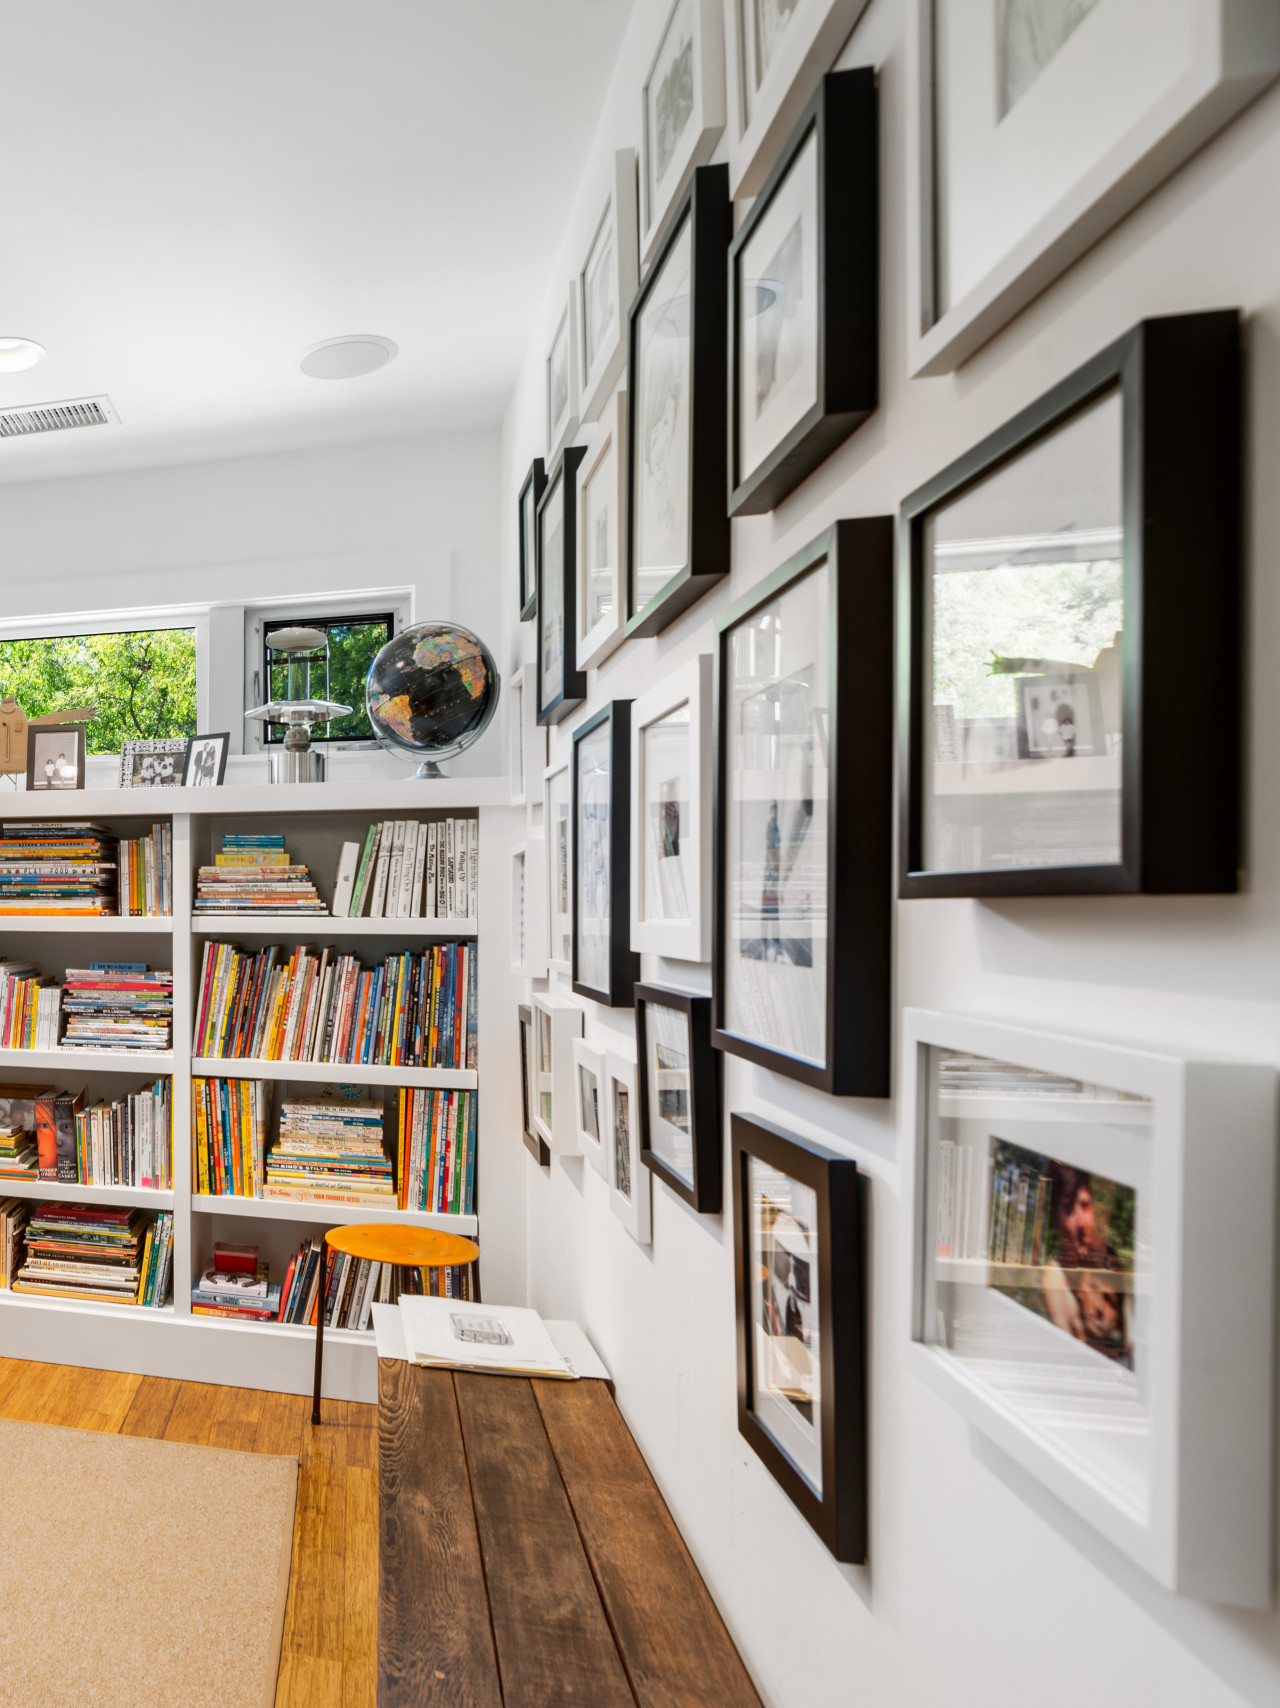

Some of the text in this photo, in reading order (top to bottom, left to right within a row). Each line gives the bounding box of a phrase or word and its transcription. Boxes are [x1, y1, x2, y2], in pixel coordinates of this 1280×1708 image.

[405, 848, 414, 862] Every
[404, 863, 412, 878] Thing
[459, 872, 465, 882] Up
